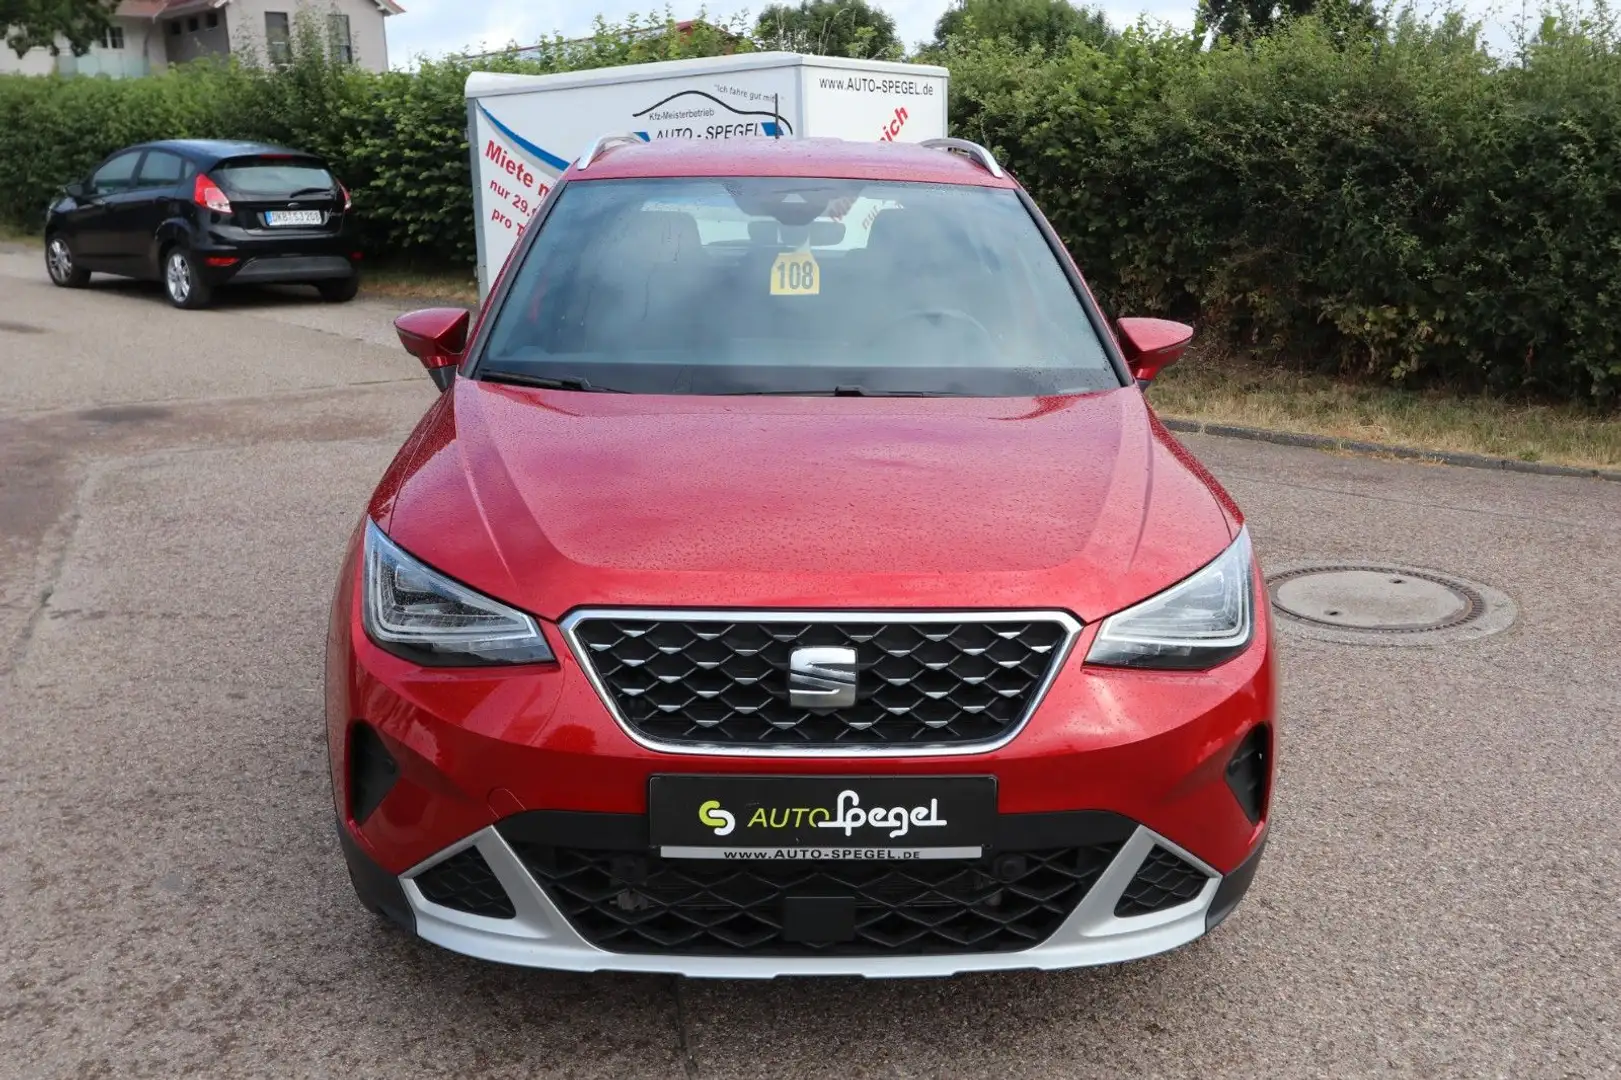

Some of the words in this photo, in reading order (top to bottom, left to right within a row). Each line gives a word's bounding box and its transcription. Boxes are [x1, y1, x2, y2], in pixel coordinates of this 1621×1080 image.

[730, 87, 748, 98] fahre
[749, 92, 762, 101] gut
[819, 78, 933, 96] www.AUTO-SPEGEL.de
[649, 109, 715, 121] Kfz-Meisterbetrieb
[486, 140, 533, 188] Miete
[490, 180, 510, 199] nur
[491, 208, 512, 229] pro
[777, 261, 814, 290] 108
